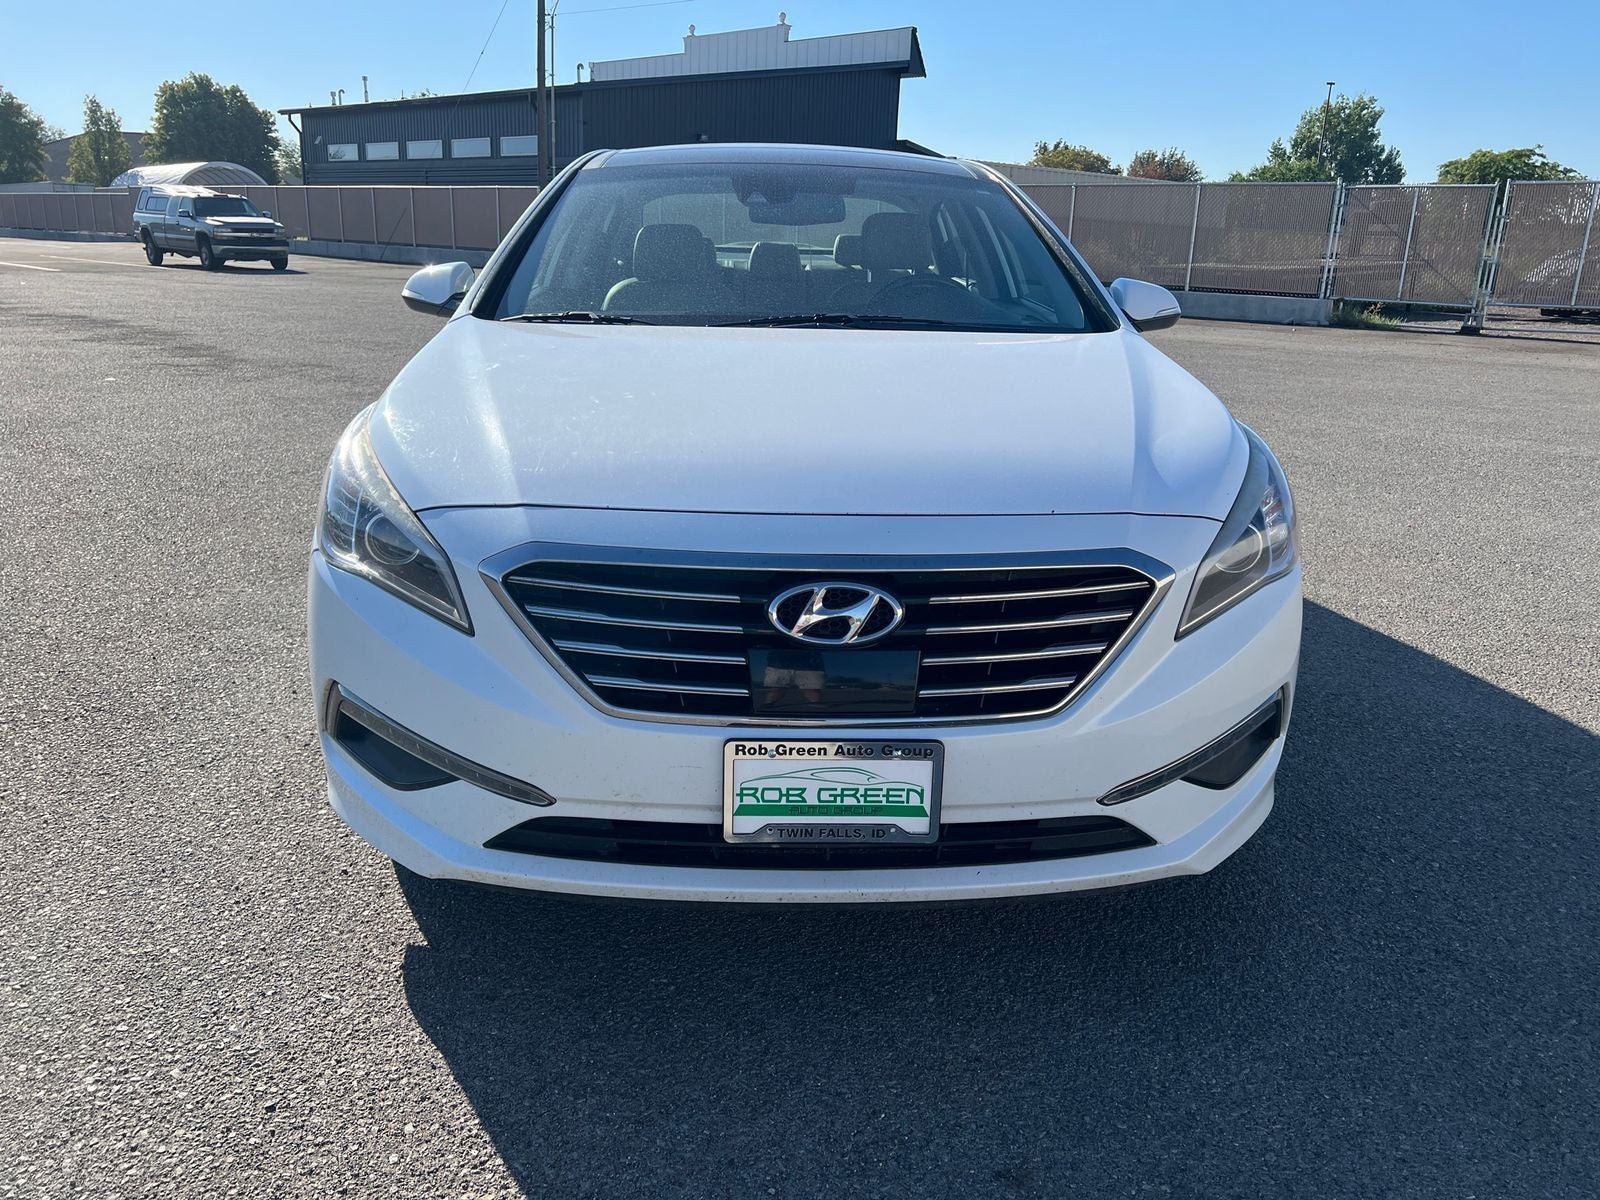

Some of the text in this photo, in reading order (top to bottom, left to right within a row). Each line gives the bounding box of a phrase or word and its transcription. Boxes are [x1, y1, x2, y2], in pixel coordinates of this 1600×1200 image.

[734, 744, 768, 756] Rob
[775, 744, 828, 756] Green
[834, 744, 874, 756] Auto
[736, 787, 925, 805] ROB GREEN
[789, 806, 883, 815] AUTO GROUP
[777, 828, 886, 840] TWIN FALLS, ID
